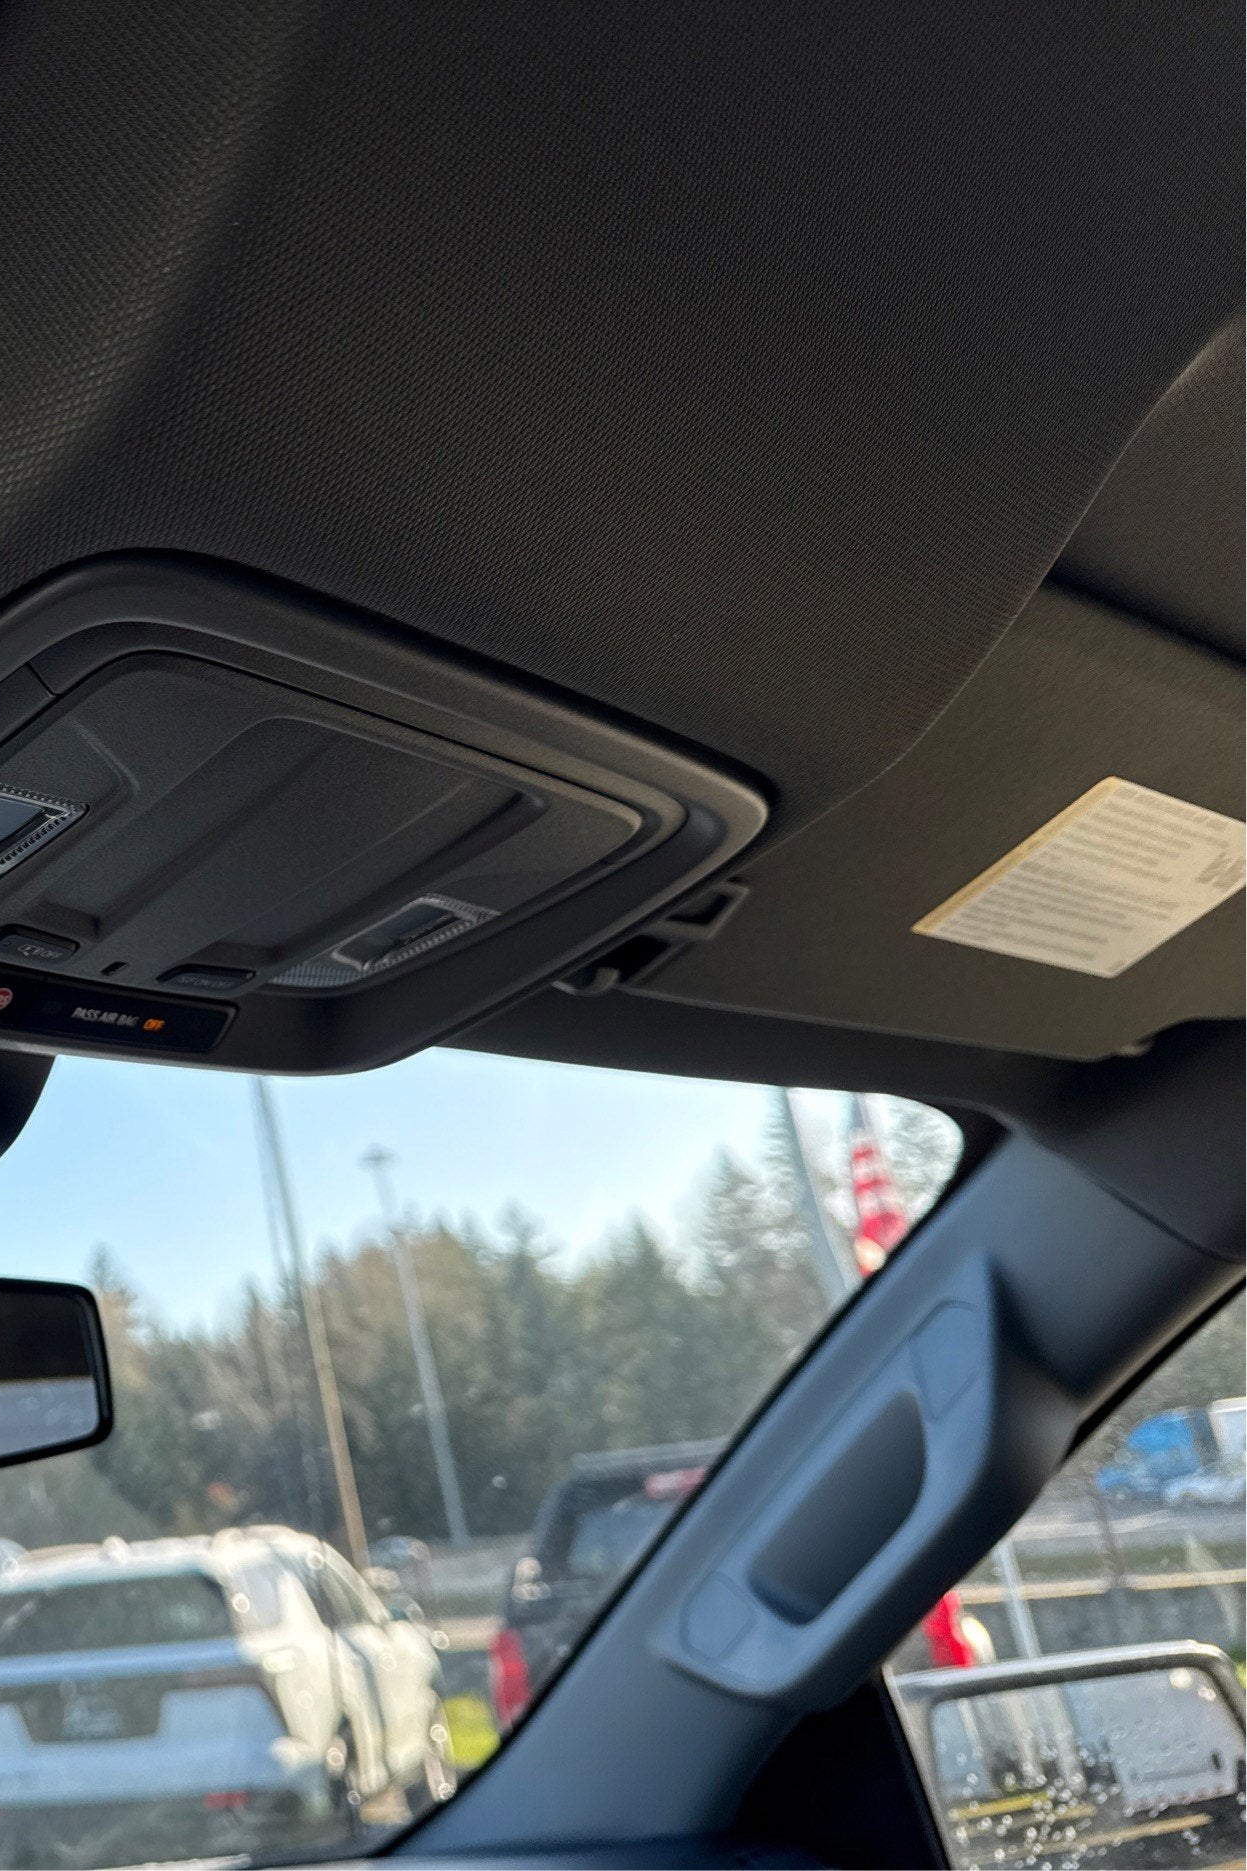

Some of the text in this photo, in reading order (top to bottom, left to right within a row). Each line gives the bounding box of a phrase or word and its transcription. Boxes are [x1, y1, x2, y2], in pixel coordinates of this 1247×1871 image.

[71, 1007, 166, 1032] PASS AIR BAG OFF
